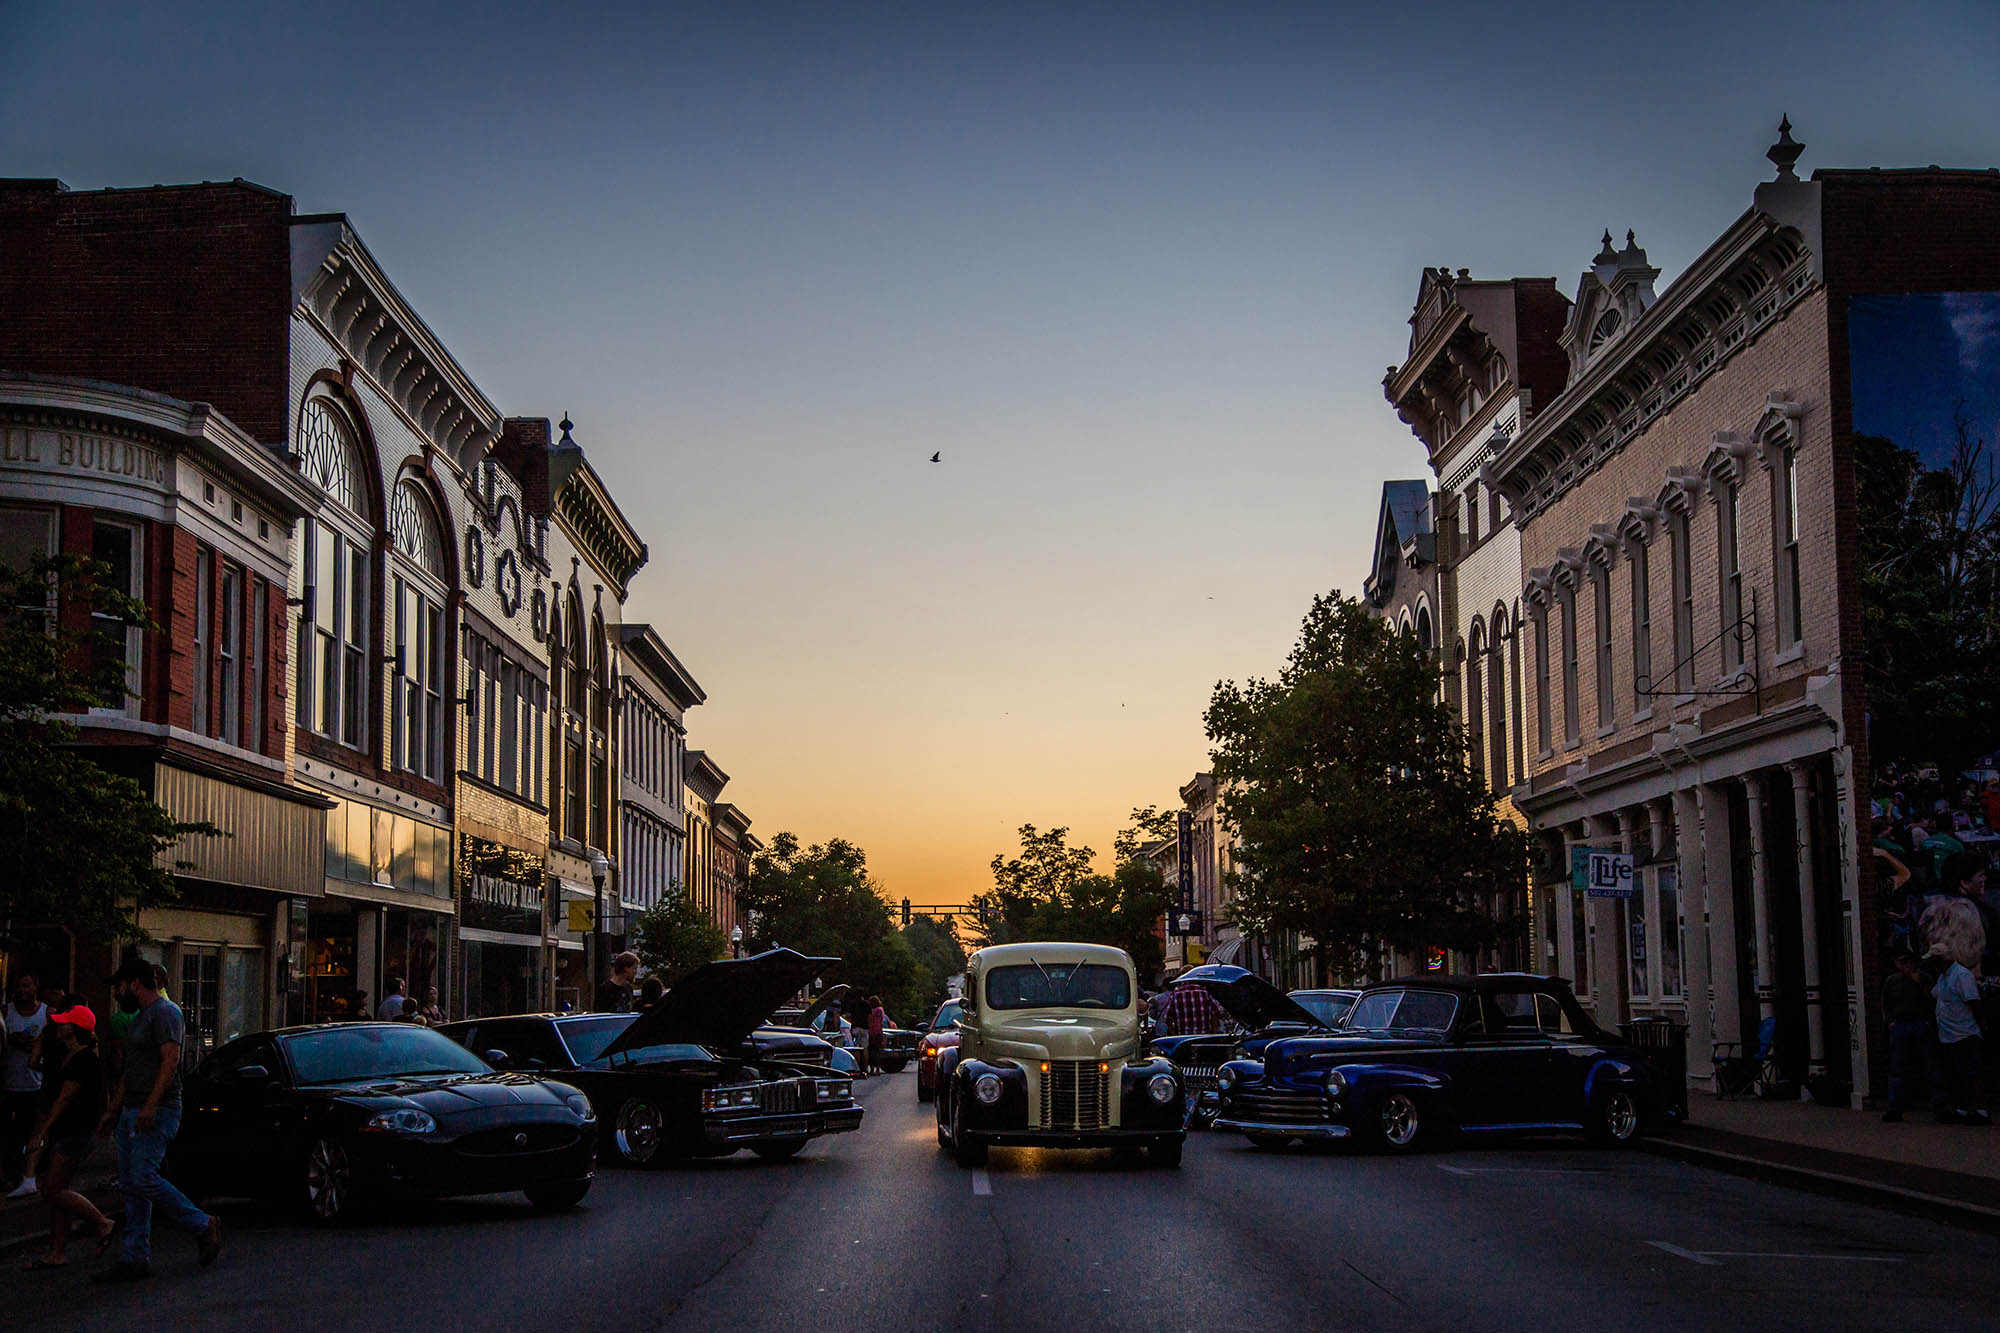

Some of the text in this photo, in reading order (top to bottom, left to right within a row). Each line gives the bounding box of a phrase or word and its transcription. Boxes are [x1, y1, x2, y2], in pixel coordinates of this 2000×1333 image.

[60, 432, 163, 485] BUILDING
[1181, 814, 1191, 910] FRIGIDAIRE
[472, 872, 541, 911] ANTIQUE MALL
